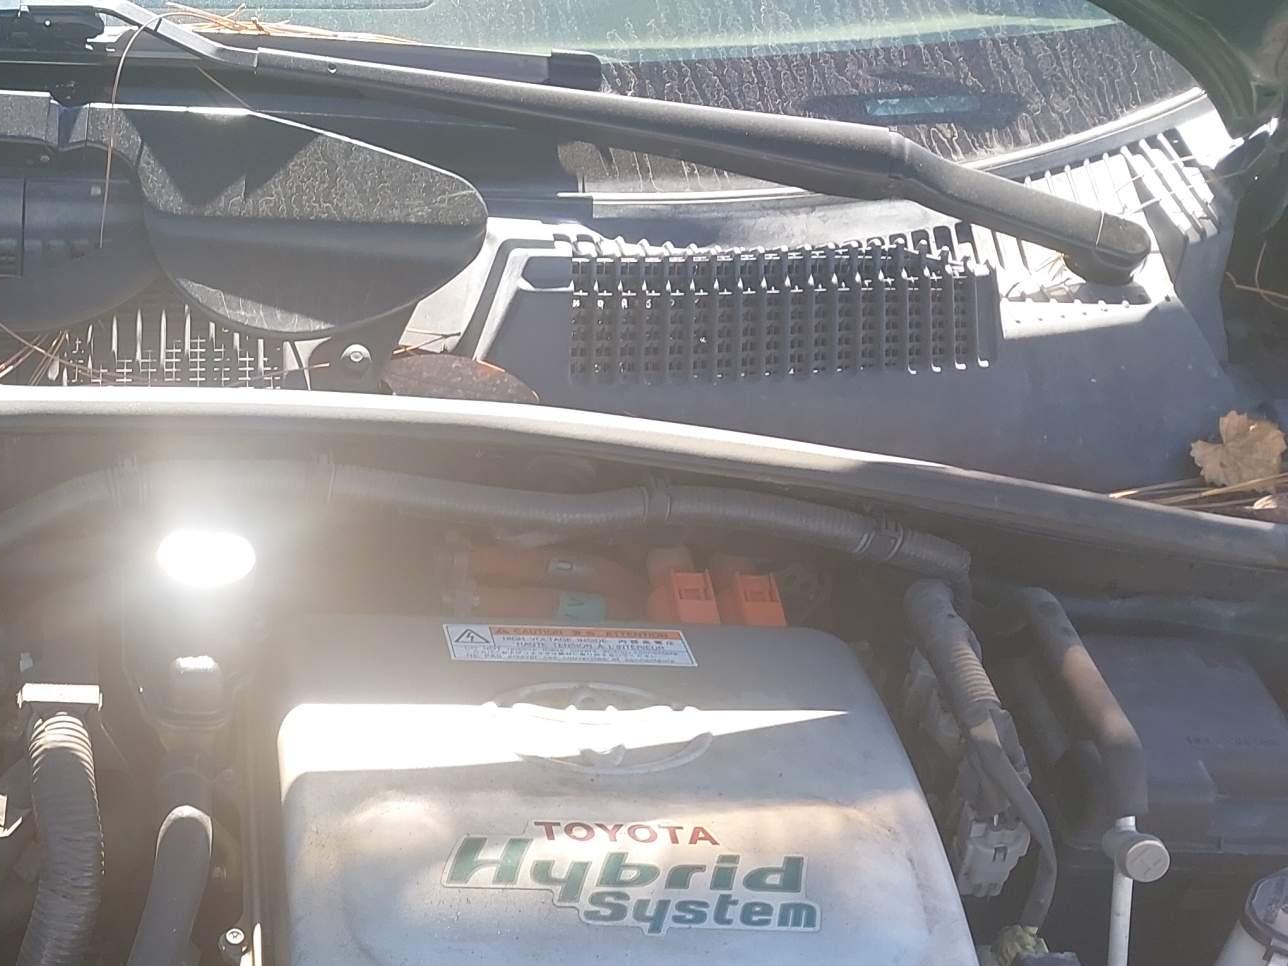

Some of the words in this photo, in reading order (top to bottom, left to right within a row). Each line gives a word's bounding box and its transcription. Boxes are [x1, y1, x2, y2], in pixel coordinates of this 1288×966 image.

[534, 821, 720, 846] TOYOTA
[447, 836, 804, 902] Hybrid
[583, 890, 817, 934] System
